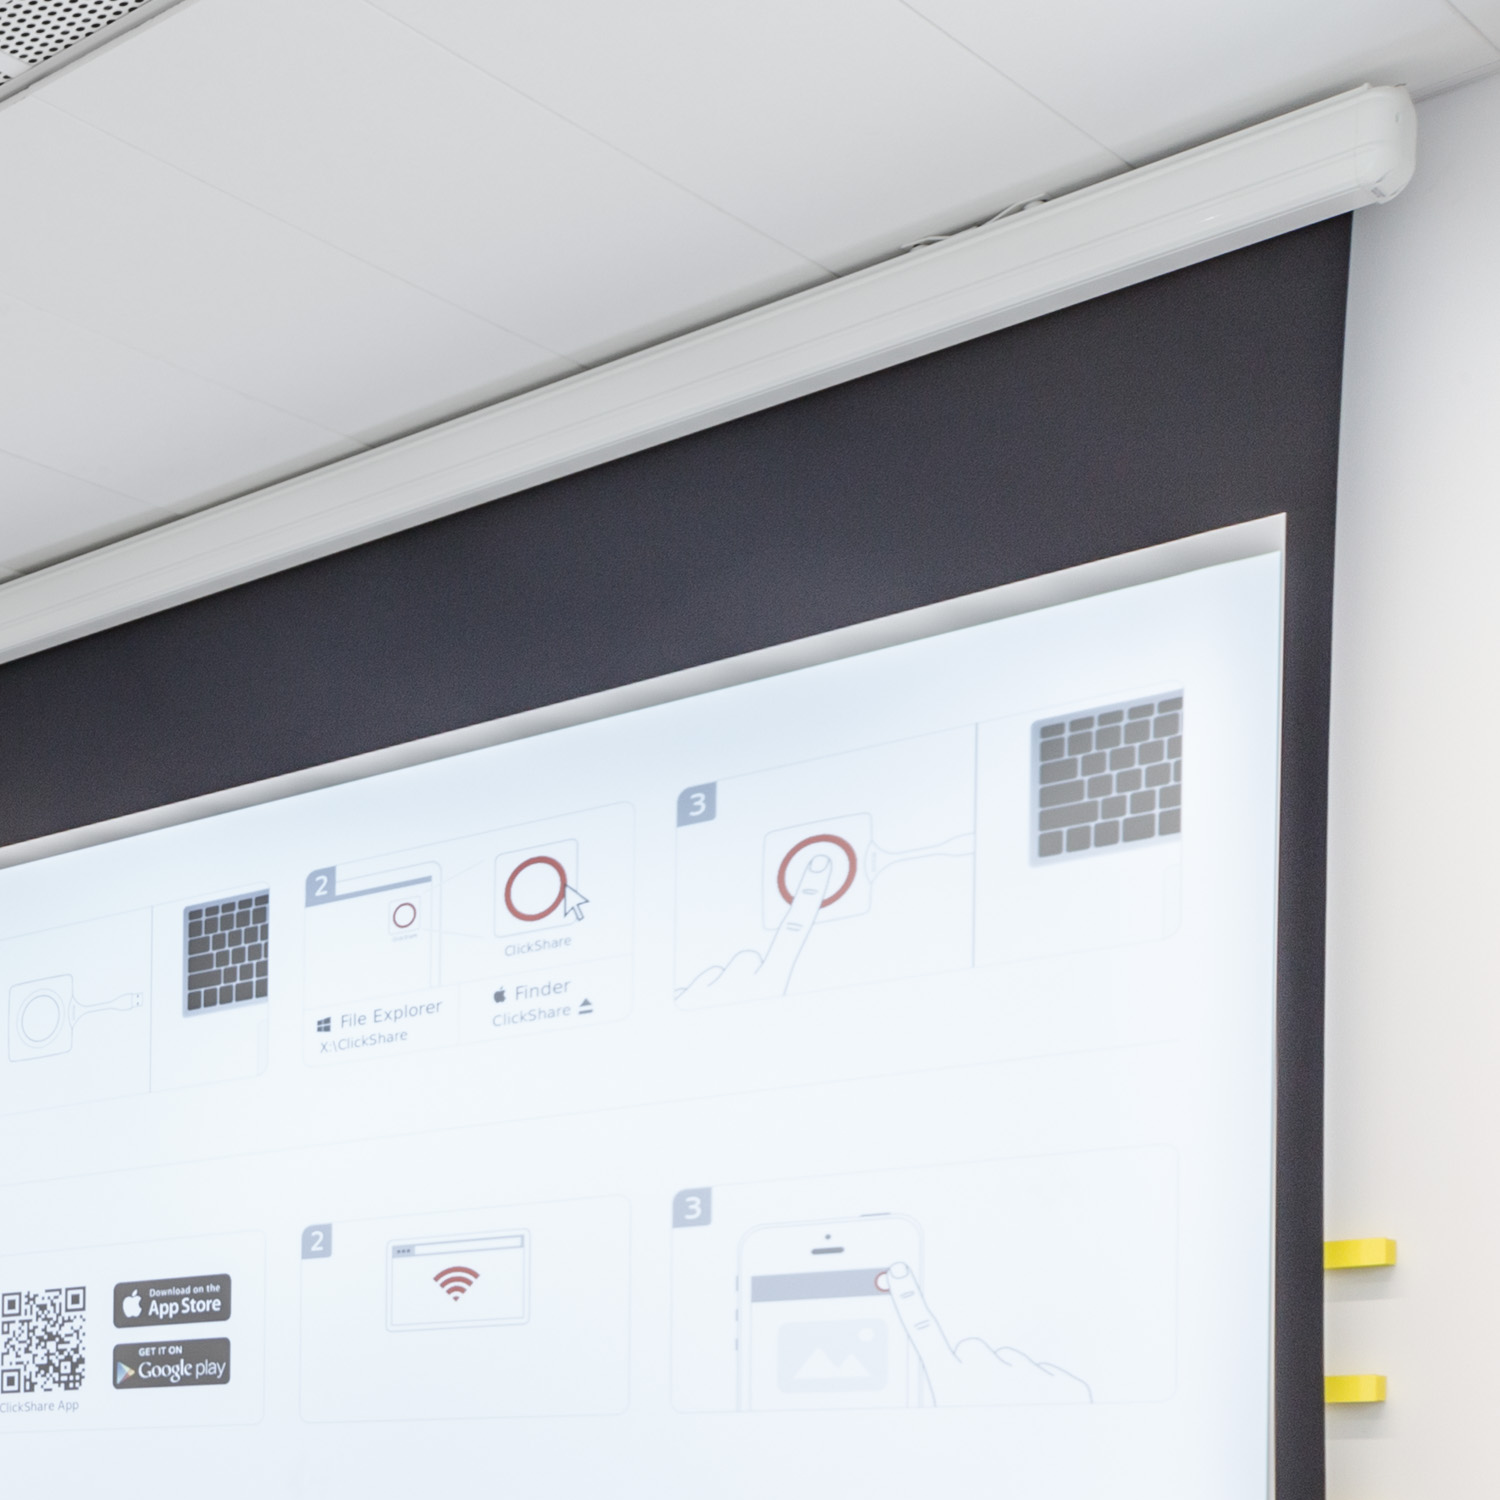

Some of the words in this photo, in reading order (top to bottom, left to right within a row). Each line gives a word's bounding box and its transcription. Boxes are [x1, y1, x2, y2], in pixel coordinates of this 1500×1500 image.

[687, 792, 707, 818] 3
[313, 875, 329, 897] 2
[504, 937, 572, 957] ClickShare
[515, 981, 571, 1000] Finder
[341, 1012, 367, 1028] File
[373, 1001, 443, 1023] Explorer
[492, 1006, 571, 1027] ClickShare
[685, 1196, 702, 1220] 3
[310, 1230, 325, 1252] 2
[149, 1285, 191, 1298] Download
[193, 1285, 204, 1294] on
[206, 1283, 221, 1293] the
[148, 1299, 180, 1320] App
[181, 1297, 222, 1314] Store
[138, 1347, 156, 1357] GET
[158, 1346, 167, 1355] IT
[168, 1345, 183, 1355] ON
[138, 1358, 193, 1383] Google
[195, 1359, 226, 1379] play
[0, 1401, 55, 1413] ClickShare
[58, 1400, 80, 1413] App
